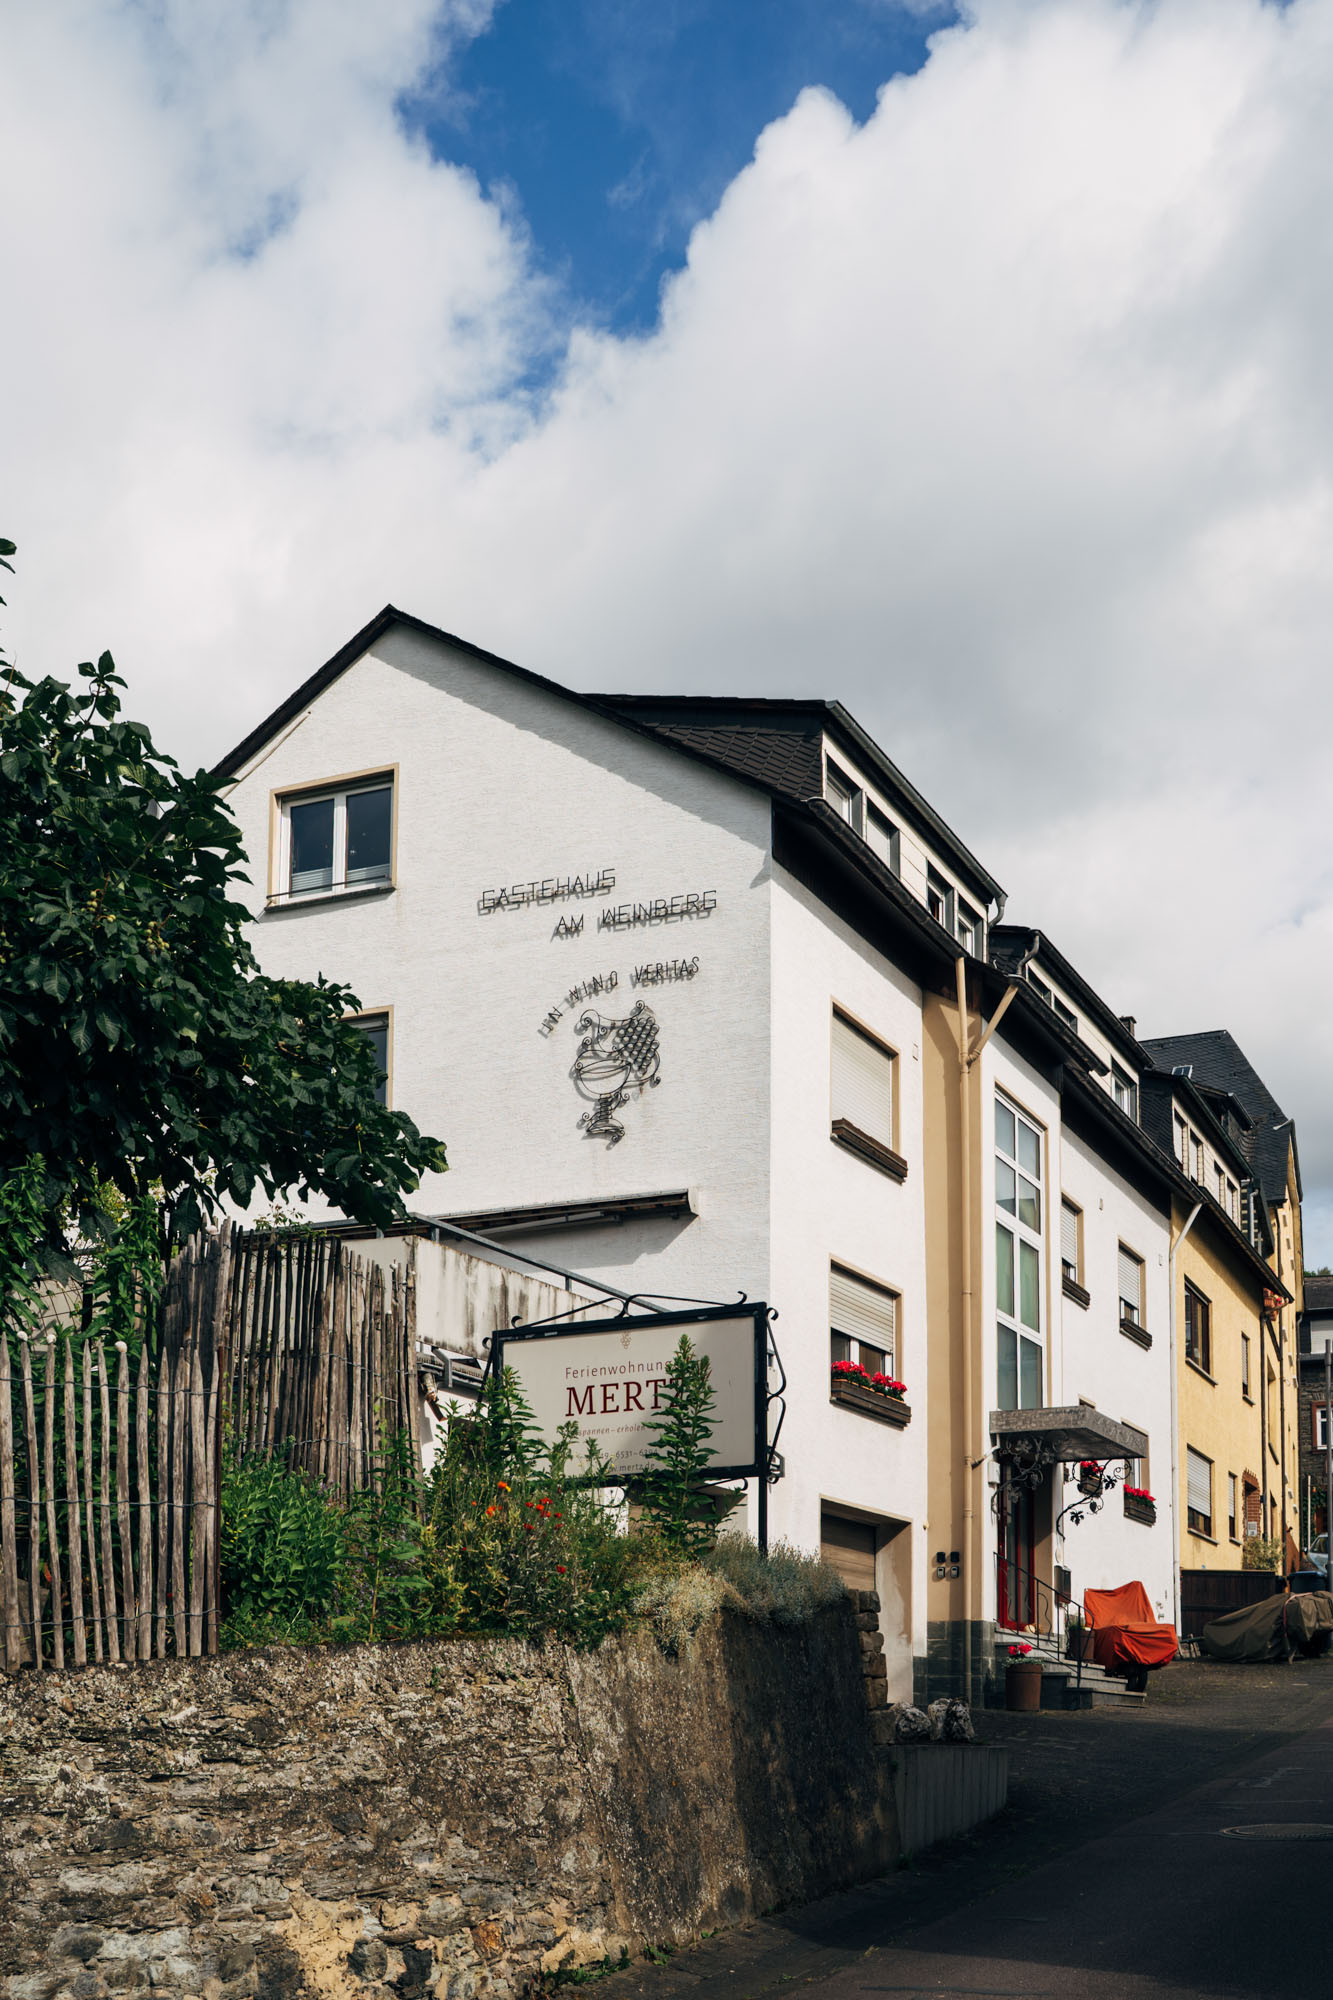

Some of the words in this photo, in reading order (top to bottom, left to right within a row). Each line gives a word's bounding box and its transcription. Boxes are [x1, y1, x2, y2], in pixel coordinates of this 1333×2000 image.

[556, 913, 584, 935] AM
[602, 889, 717, 925] WEINBERG
[569, 970, 618, 1001] VINO
[634, 956, 700, 982] VERITAS
[565, 1361, 673, 1379] Ferienwohnung
